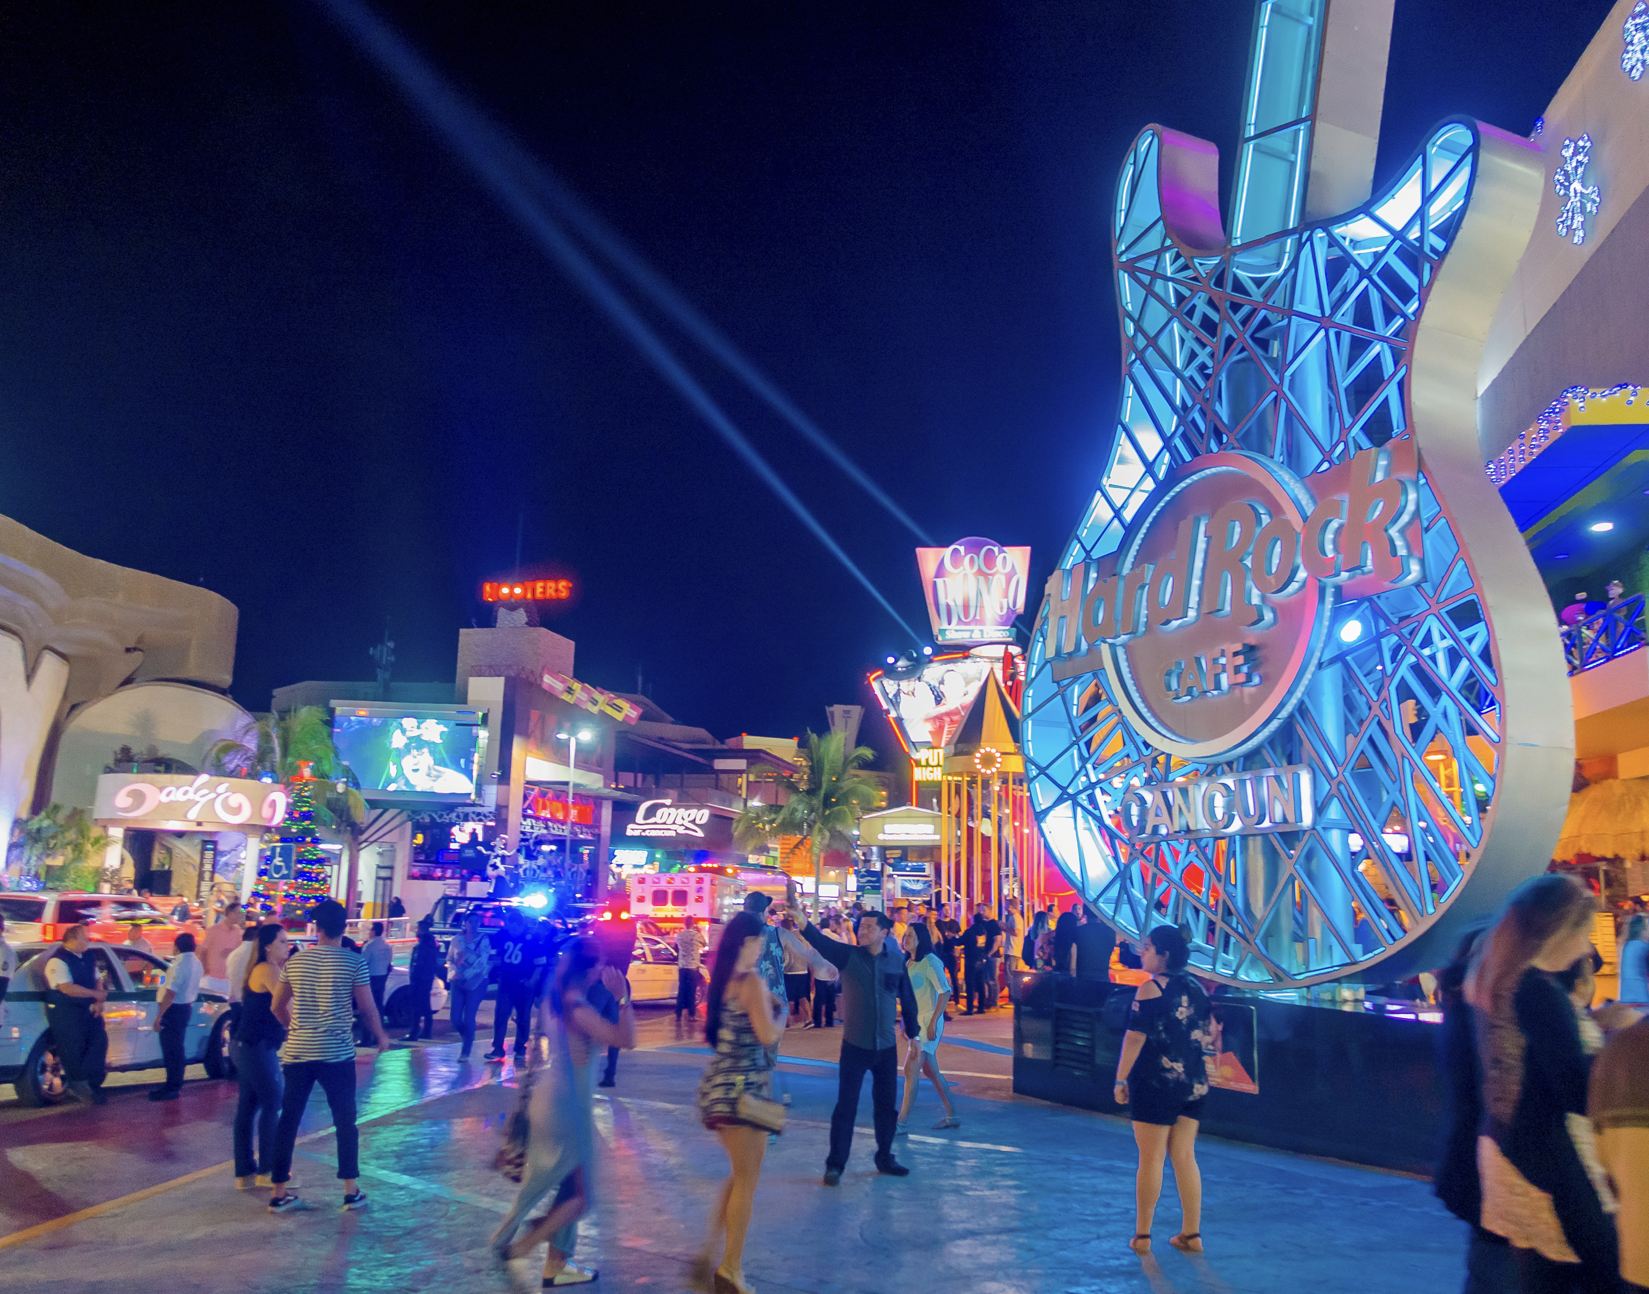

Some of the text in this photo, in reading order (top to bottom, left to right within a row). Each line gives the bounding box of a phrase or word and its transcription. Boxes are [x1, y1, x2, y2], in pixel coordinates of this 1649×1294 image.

[1044, 447, 1424, 662] Hard Rock
[483, 579, 573, 602] HOOTERS
[933, 574, 1026, 627] BONGO
[635, 798, 710, 838] Congo
[1120, 770, 1306, 840] CANCUN
[504, 941, 522, 964] 26
